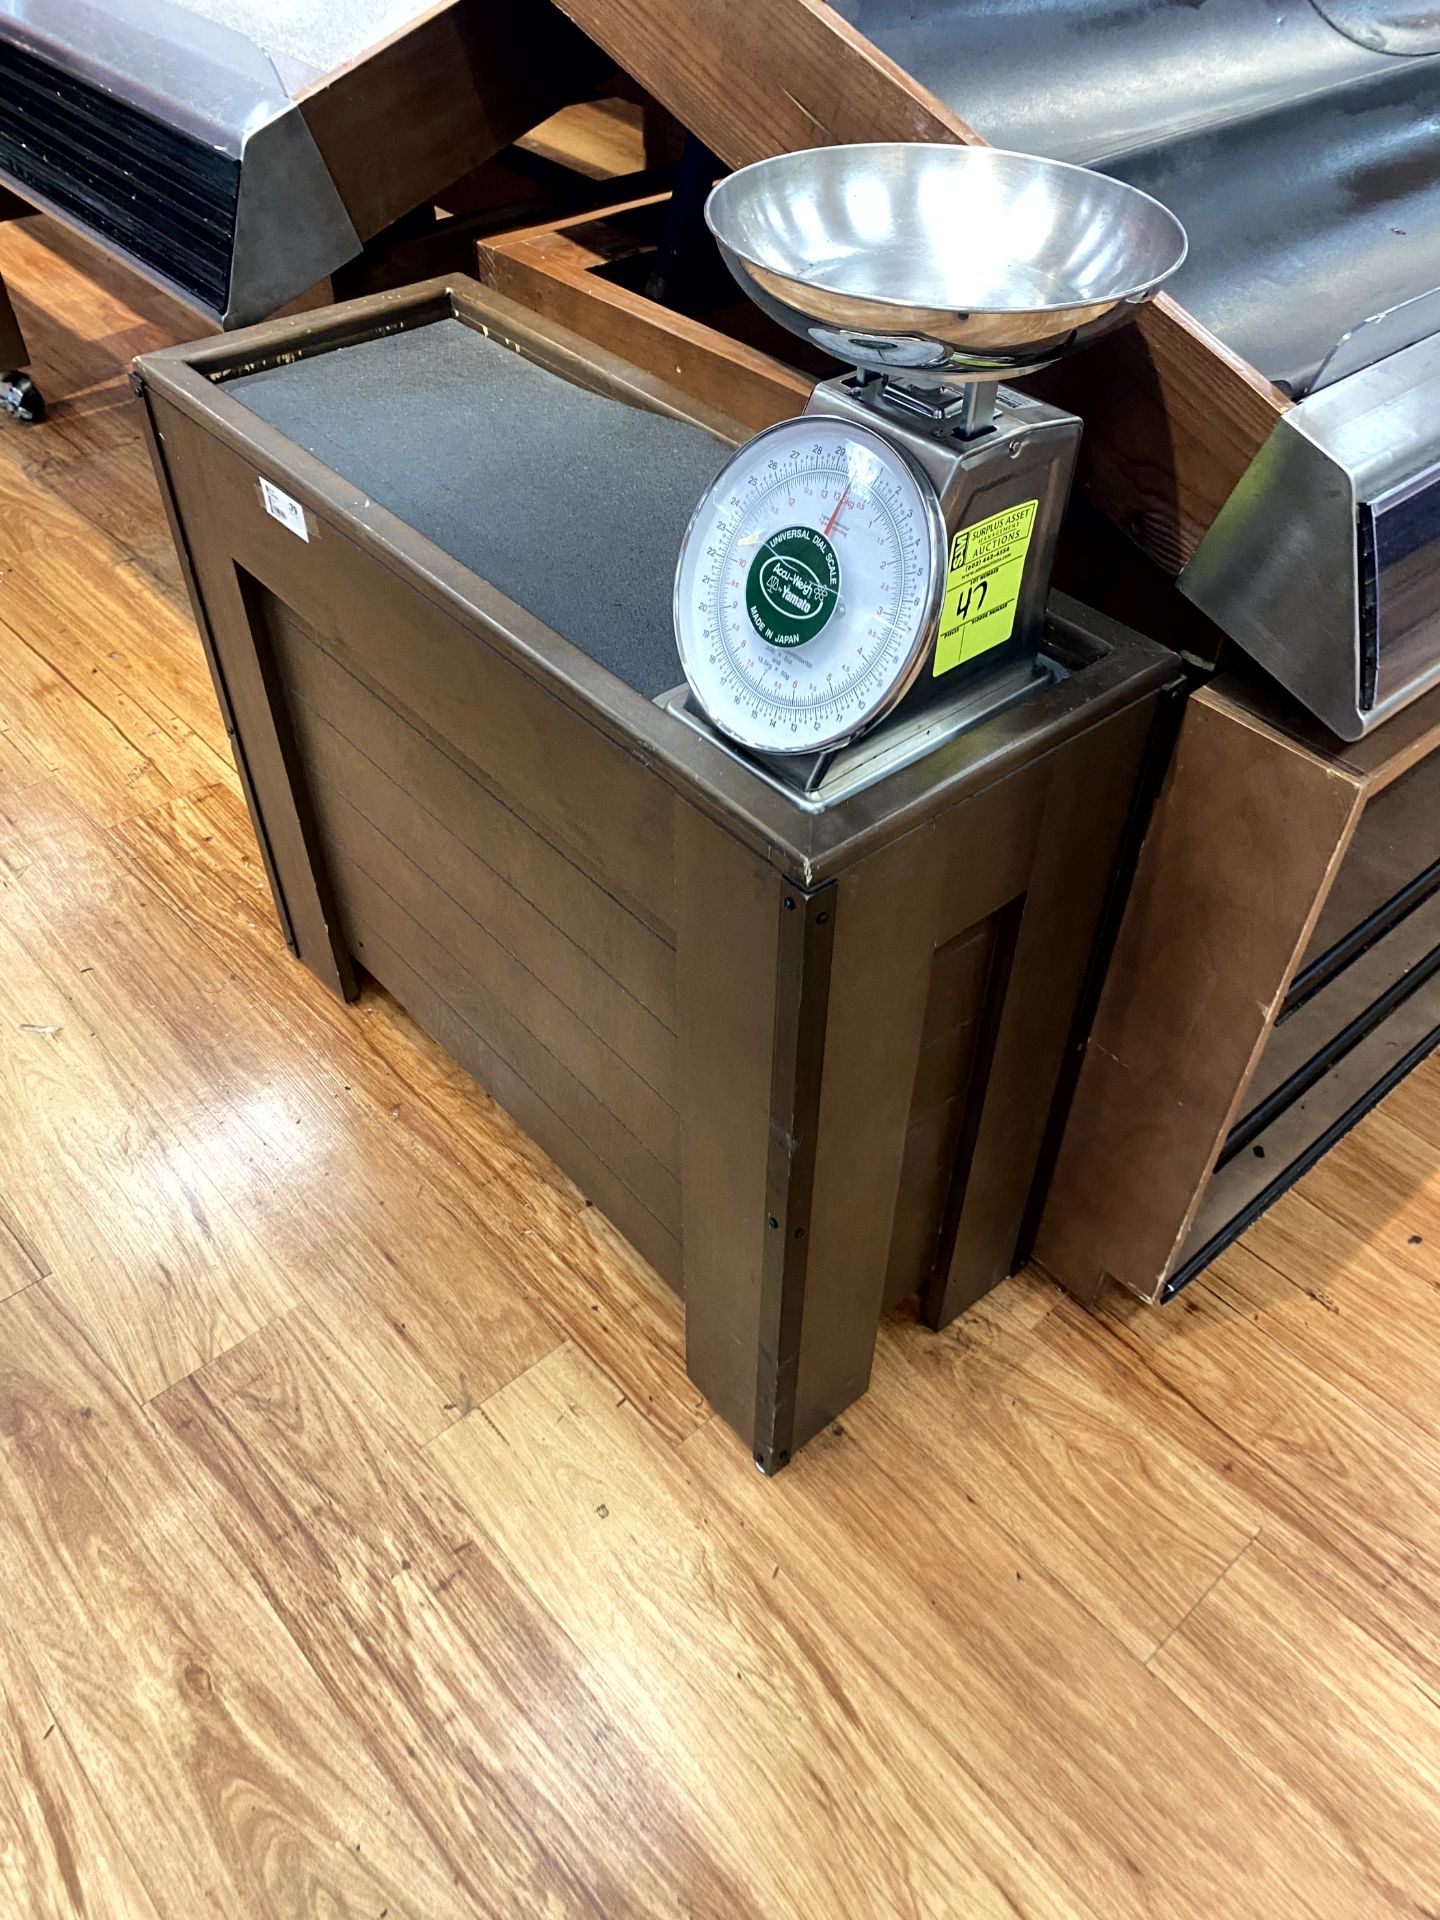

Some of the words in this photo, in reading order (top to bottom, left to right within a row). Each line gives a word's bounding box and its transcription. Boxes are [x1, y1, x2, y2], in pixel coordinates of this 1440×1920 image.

[791, 450, 800, 459] 27
[813, 445, 822, 454] 28
[835, 446, 845, 456] 29
[768, 460, 778, 470] 26
[748, 476, 757, 486] 25
[821, 489, 828, 499] 13
[730, 497, 739, 507] 24
[788, 497, 795, 507] 12
[907, 509, 913, 518] 3
[717, 521, 726, 531] 23
[972, 518, 1004, 540] SURPLUS
[1005, 508, 1030, 524] ASSET
[978, 521, 1020, 544] MANAGEMENT
[973, 530, 1020, 558] AUCTIONS
[707, 547, 716, 557] 22
[952, 534, 968, 569] SAM
[769, 529, 811, 548] UNIVERSAL
[812, 535, 828, 554] DIAL
[825, 553, 837, 585] SCALE
[739, 558, 747, 568] 10
[880, 561, 886, 570] 2
[965, 560, 981, 572] (602)
[917, 568, 923, 576] 5
[980, 567, 999, 580] NUMBER
[702, 575, 710, 584] 21
[773, 562, 813, 599] Accu-Weigh
[781, 585, 811, 613] Yamato
[956, 580, 988, 620] 47
[699, 602, 708, 612] 20
[877, 606, 883, 615] 3
[750, 605, 765, 631] MADE
[765, 628, 774, 639] IN
[774, 633, 800, 644] JAPAN
[792, 680, 798, 689] 6
[751, 710, 758, 719] 15
[769, 720, 776, 728] 14
[791, 723, 797, 732] 13
